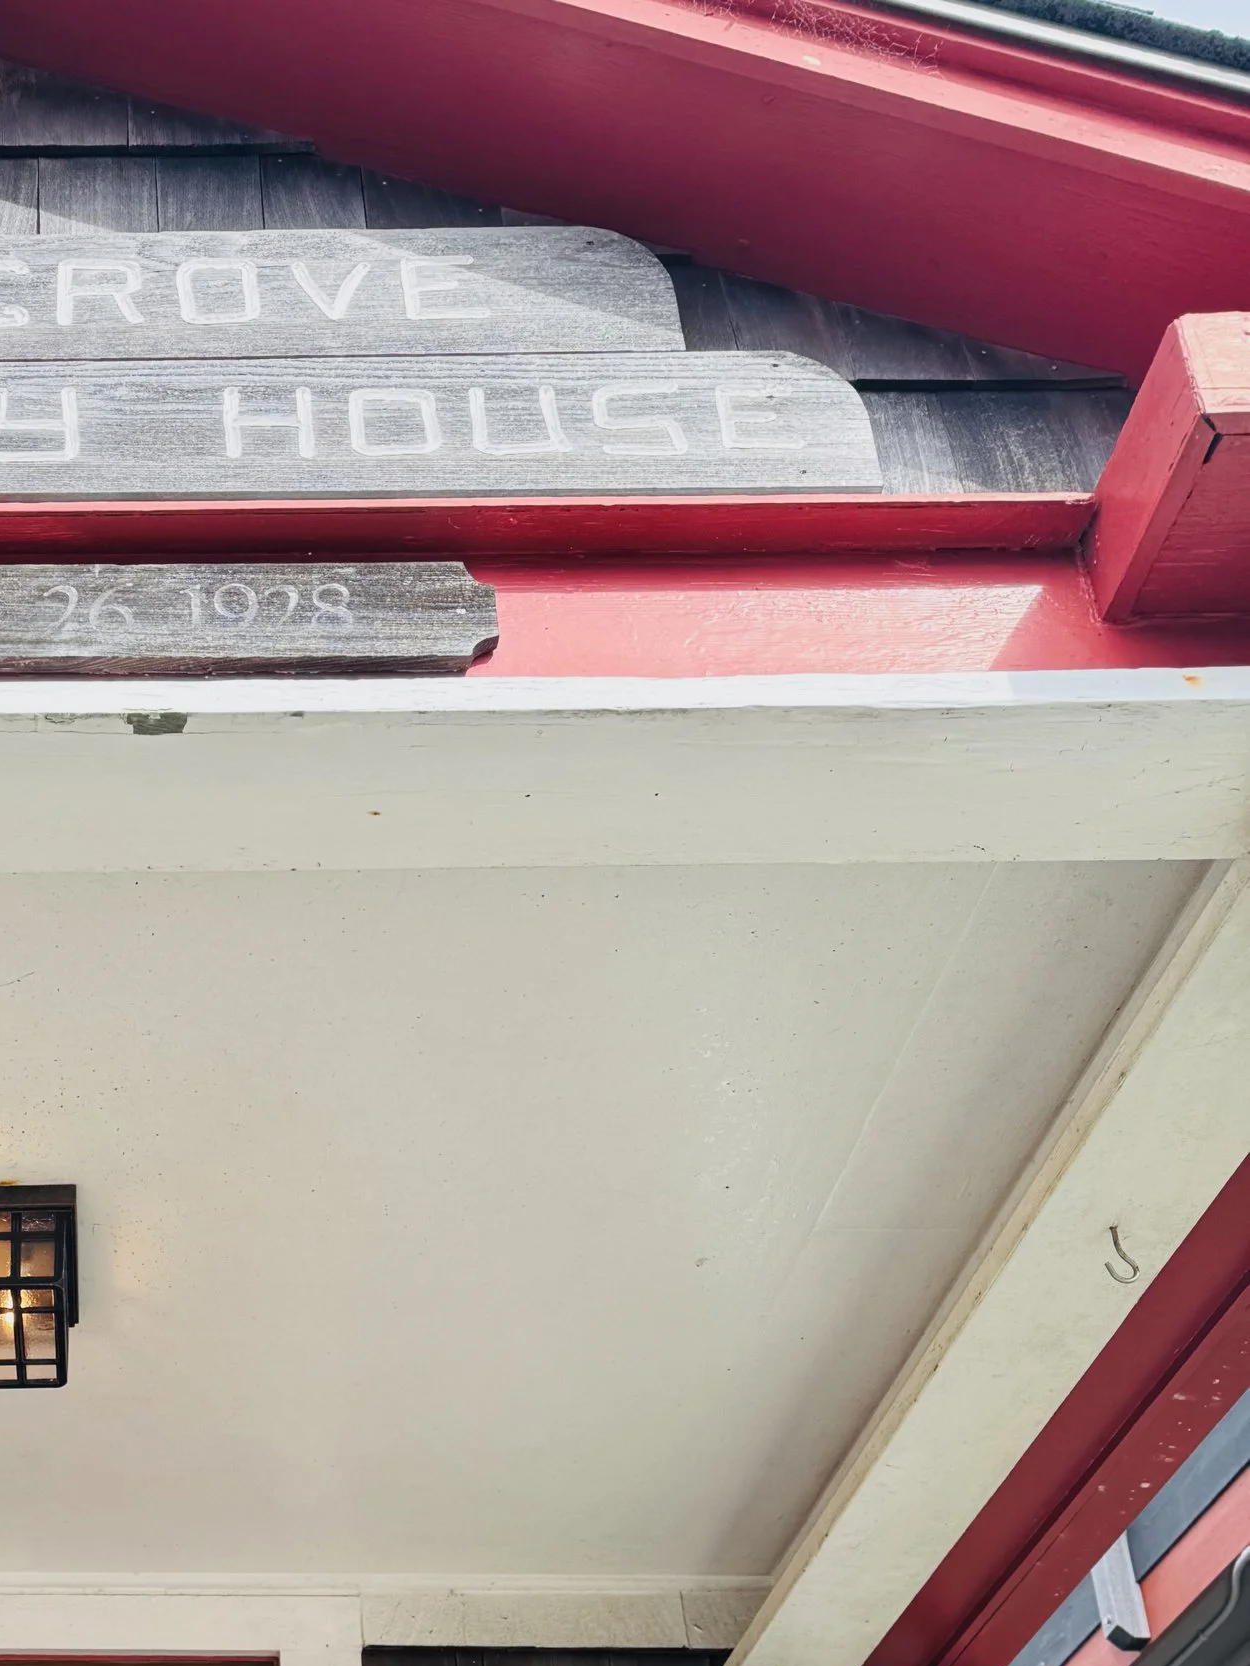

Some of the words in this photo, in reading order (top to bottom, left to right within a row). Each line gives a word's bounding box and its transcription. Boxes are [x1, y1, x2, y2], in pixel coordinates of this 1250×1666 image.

[222, 381, 806, 461] HOUSE
[42, 583, 134, 636] 26
[179, 582, 354, 634] 1928
